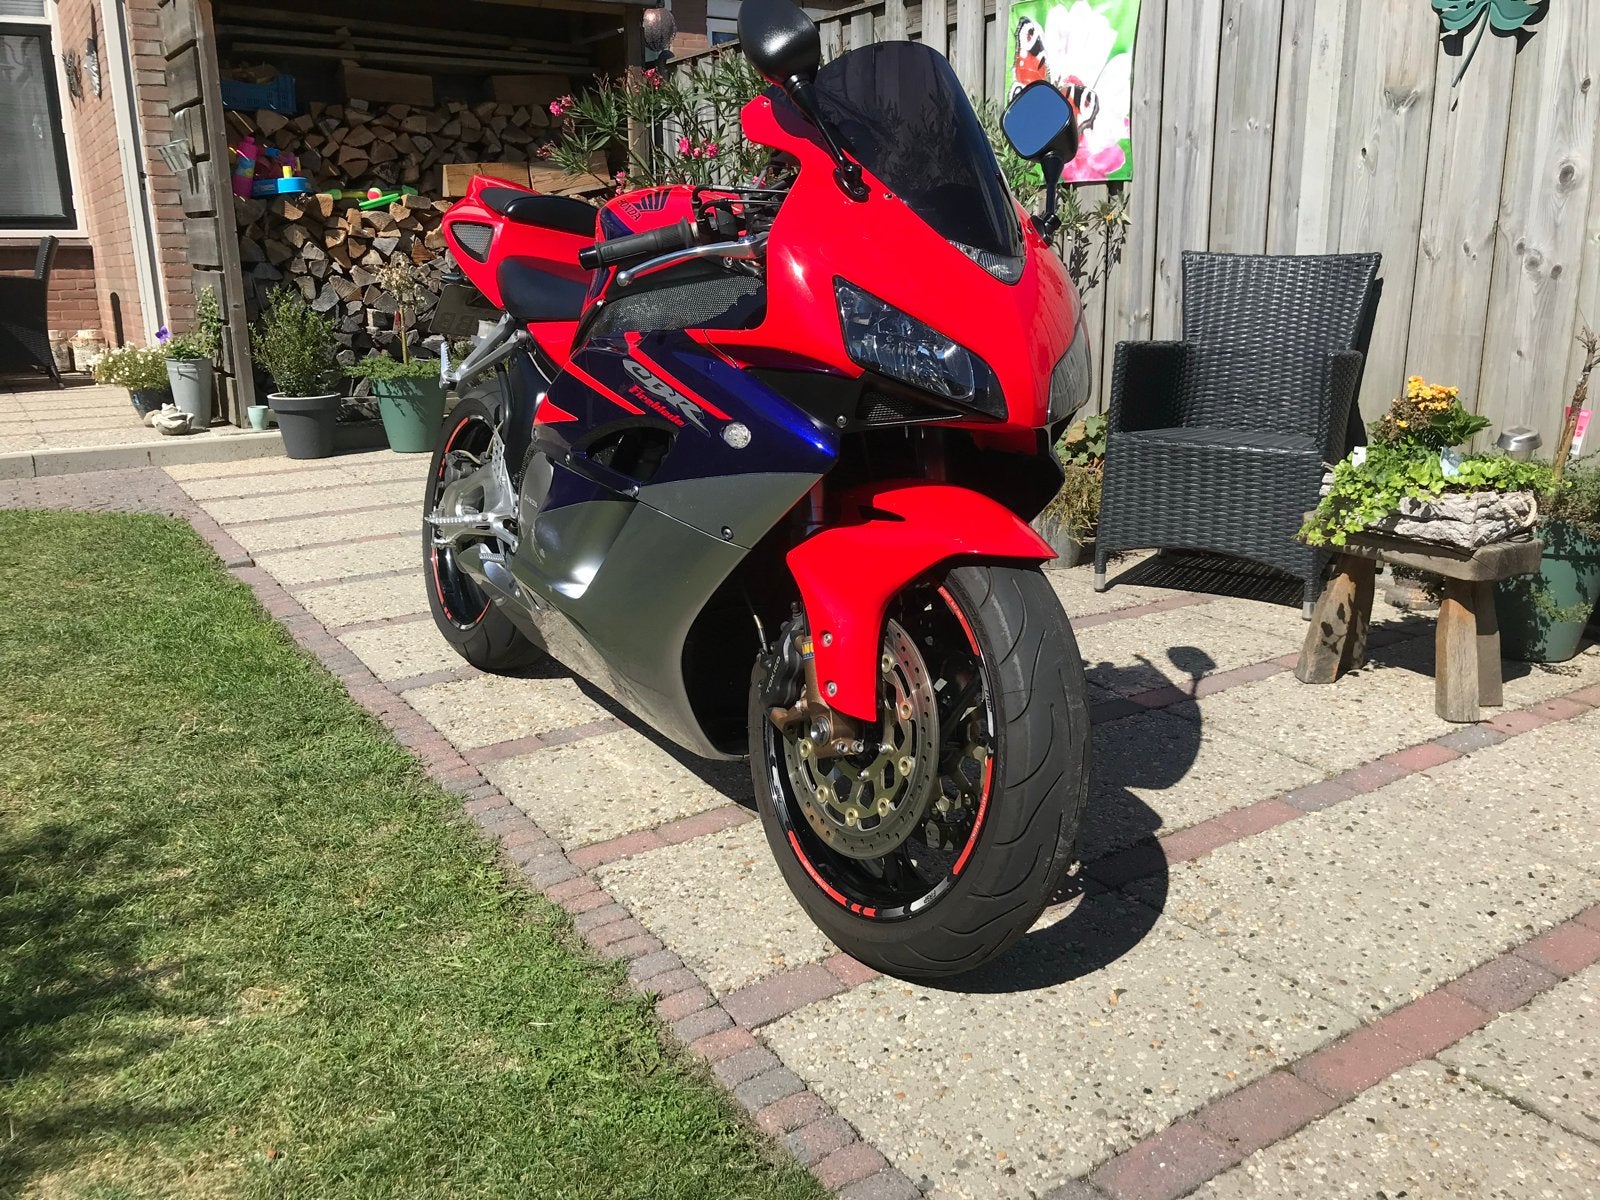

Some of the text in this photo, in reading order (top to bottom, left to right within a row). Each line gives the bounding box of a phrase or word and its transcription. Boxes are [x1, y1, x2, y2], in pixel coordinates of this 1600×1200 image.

[616, 198, 642, 222] HONDA
[622, 359, 711, 437] CBR
[628, 384, 686, 428] Fireblade
[765, 655, 781, 693] TOKICO
